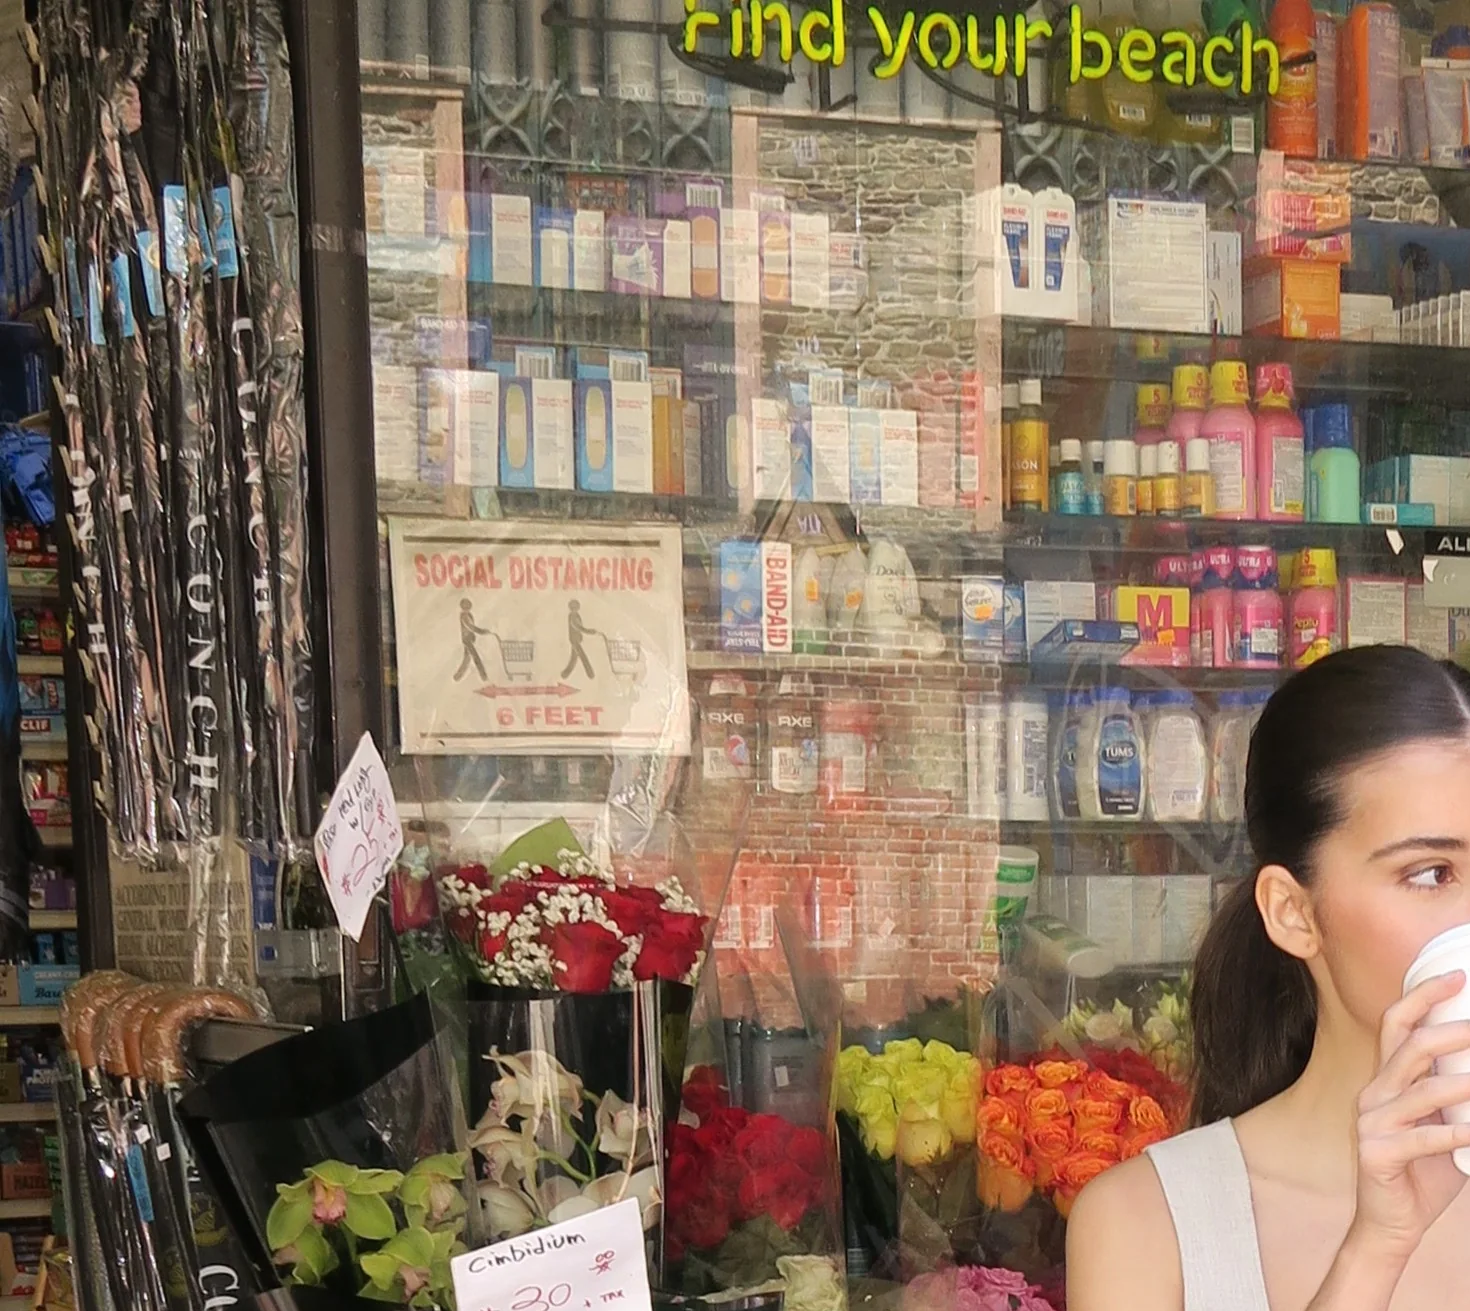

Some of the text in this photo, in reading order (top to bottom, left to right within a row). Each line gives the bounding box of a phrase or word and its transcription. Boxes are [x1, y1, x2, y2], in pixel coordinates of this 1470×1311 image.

[684, 0, 845, 66] Find
[867, 6, 1052, 80] your
[1070, 4, 1281, 96] beach
[415, 553, 654, 591] SOCIAL DISTANCING
[765, 556, 788, 648] BAND-AID
[20, 719, 49, 731] CLIF
[497, 706, 604, 726] 6 FEET
[778, 715, 813, 729] AXE
[1104, 746, 1134, 759] TUMS
[469, 1233, 586, 1273] Cimbidium
